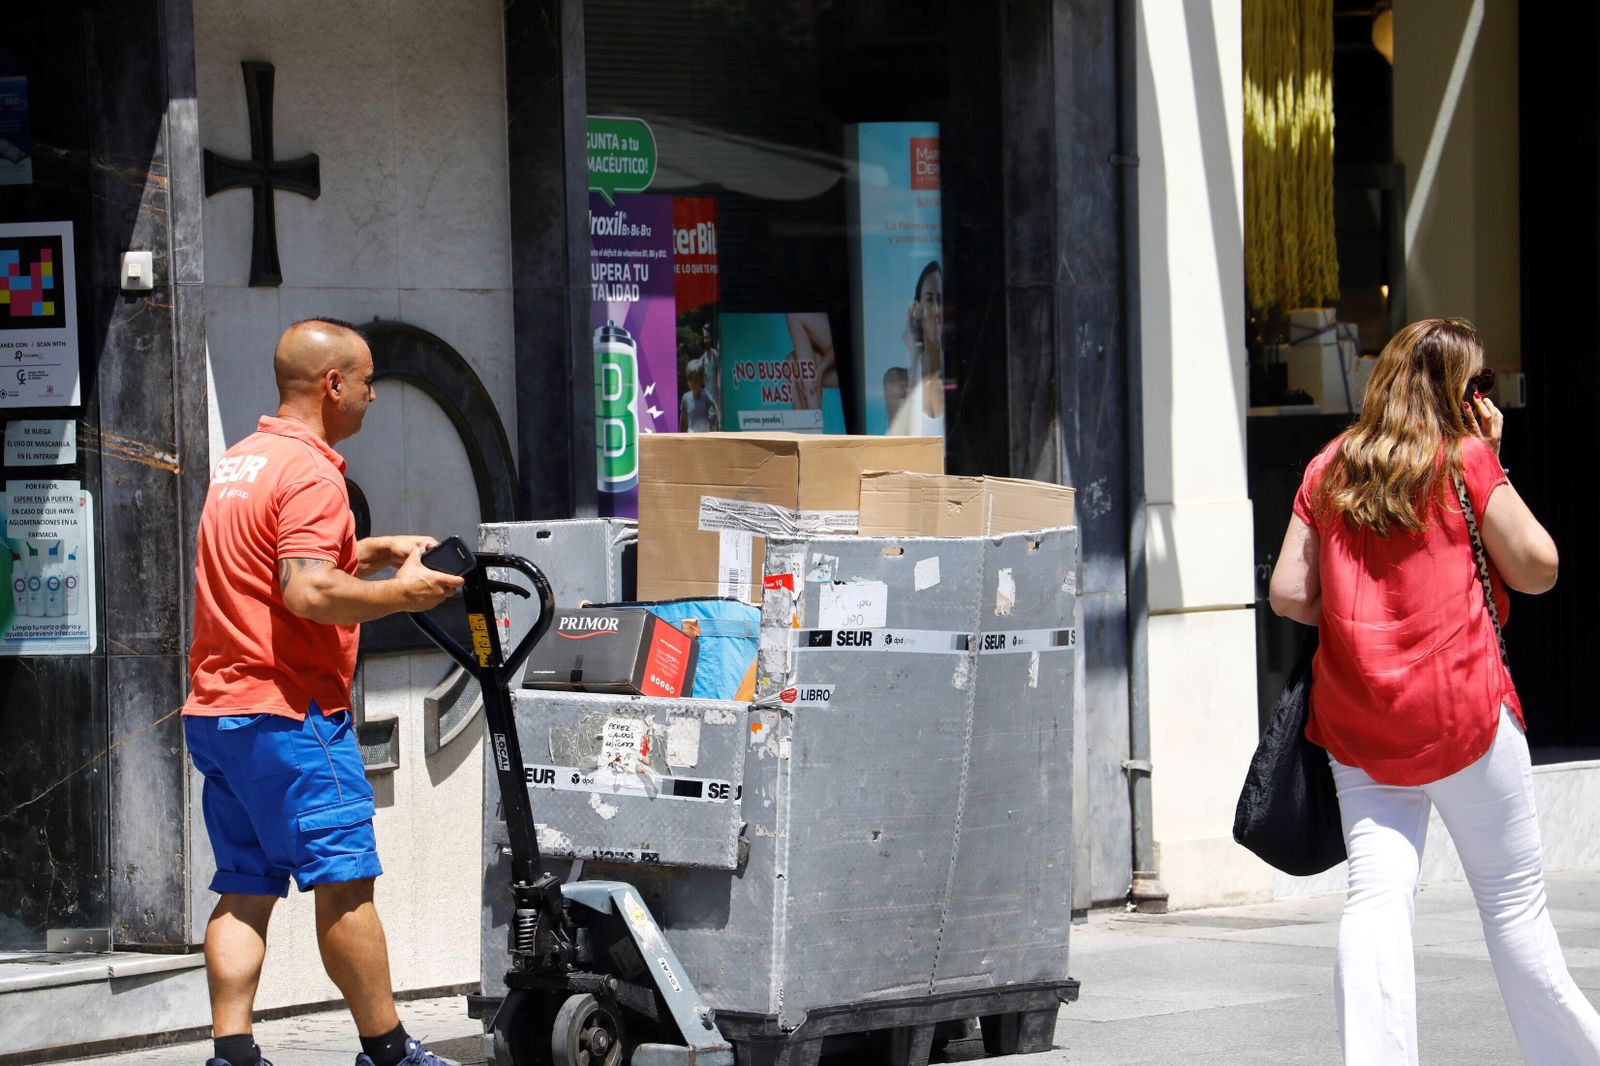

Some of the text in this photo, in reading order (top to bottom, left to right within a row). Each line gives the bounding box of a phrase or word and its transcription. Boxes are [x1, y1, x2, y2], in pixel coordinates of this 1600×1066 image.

[622, 139, 627, 150] a
[629, 137, 639, 151] tu
[591, 263, 649, 281] UPERA TU
[591, 283, 640, 302] TALIDAD
[733, 361, 816, 387] ¡NO BUSQUES
[762, 379, 793, 402] MÁS!
[558, 616, 619, 631] PRIMOR
[836, 630, 873, 647] SEUR
[984, 634, 1006, 650] SEUR
[800, 689, 831, 701] LIBRO
[496, 734, 510, 770] LOCAL
[524, 767, 556, 785] EUR
[660, 960, 681, 992] LOCAL
